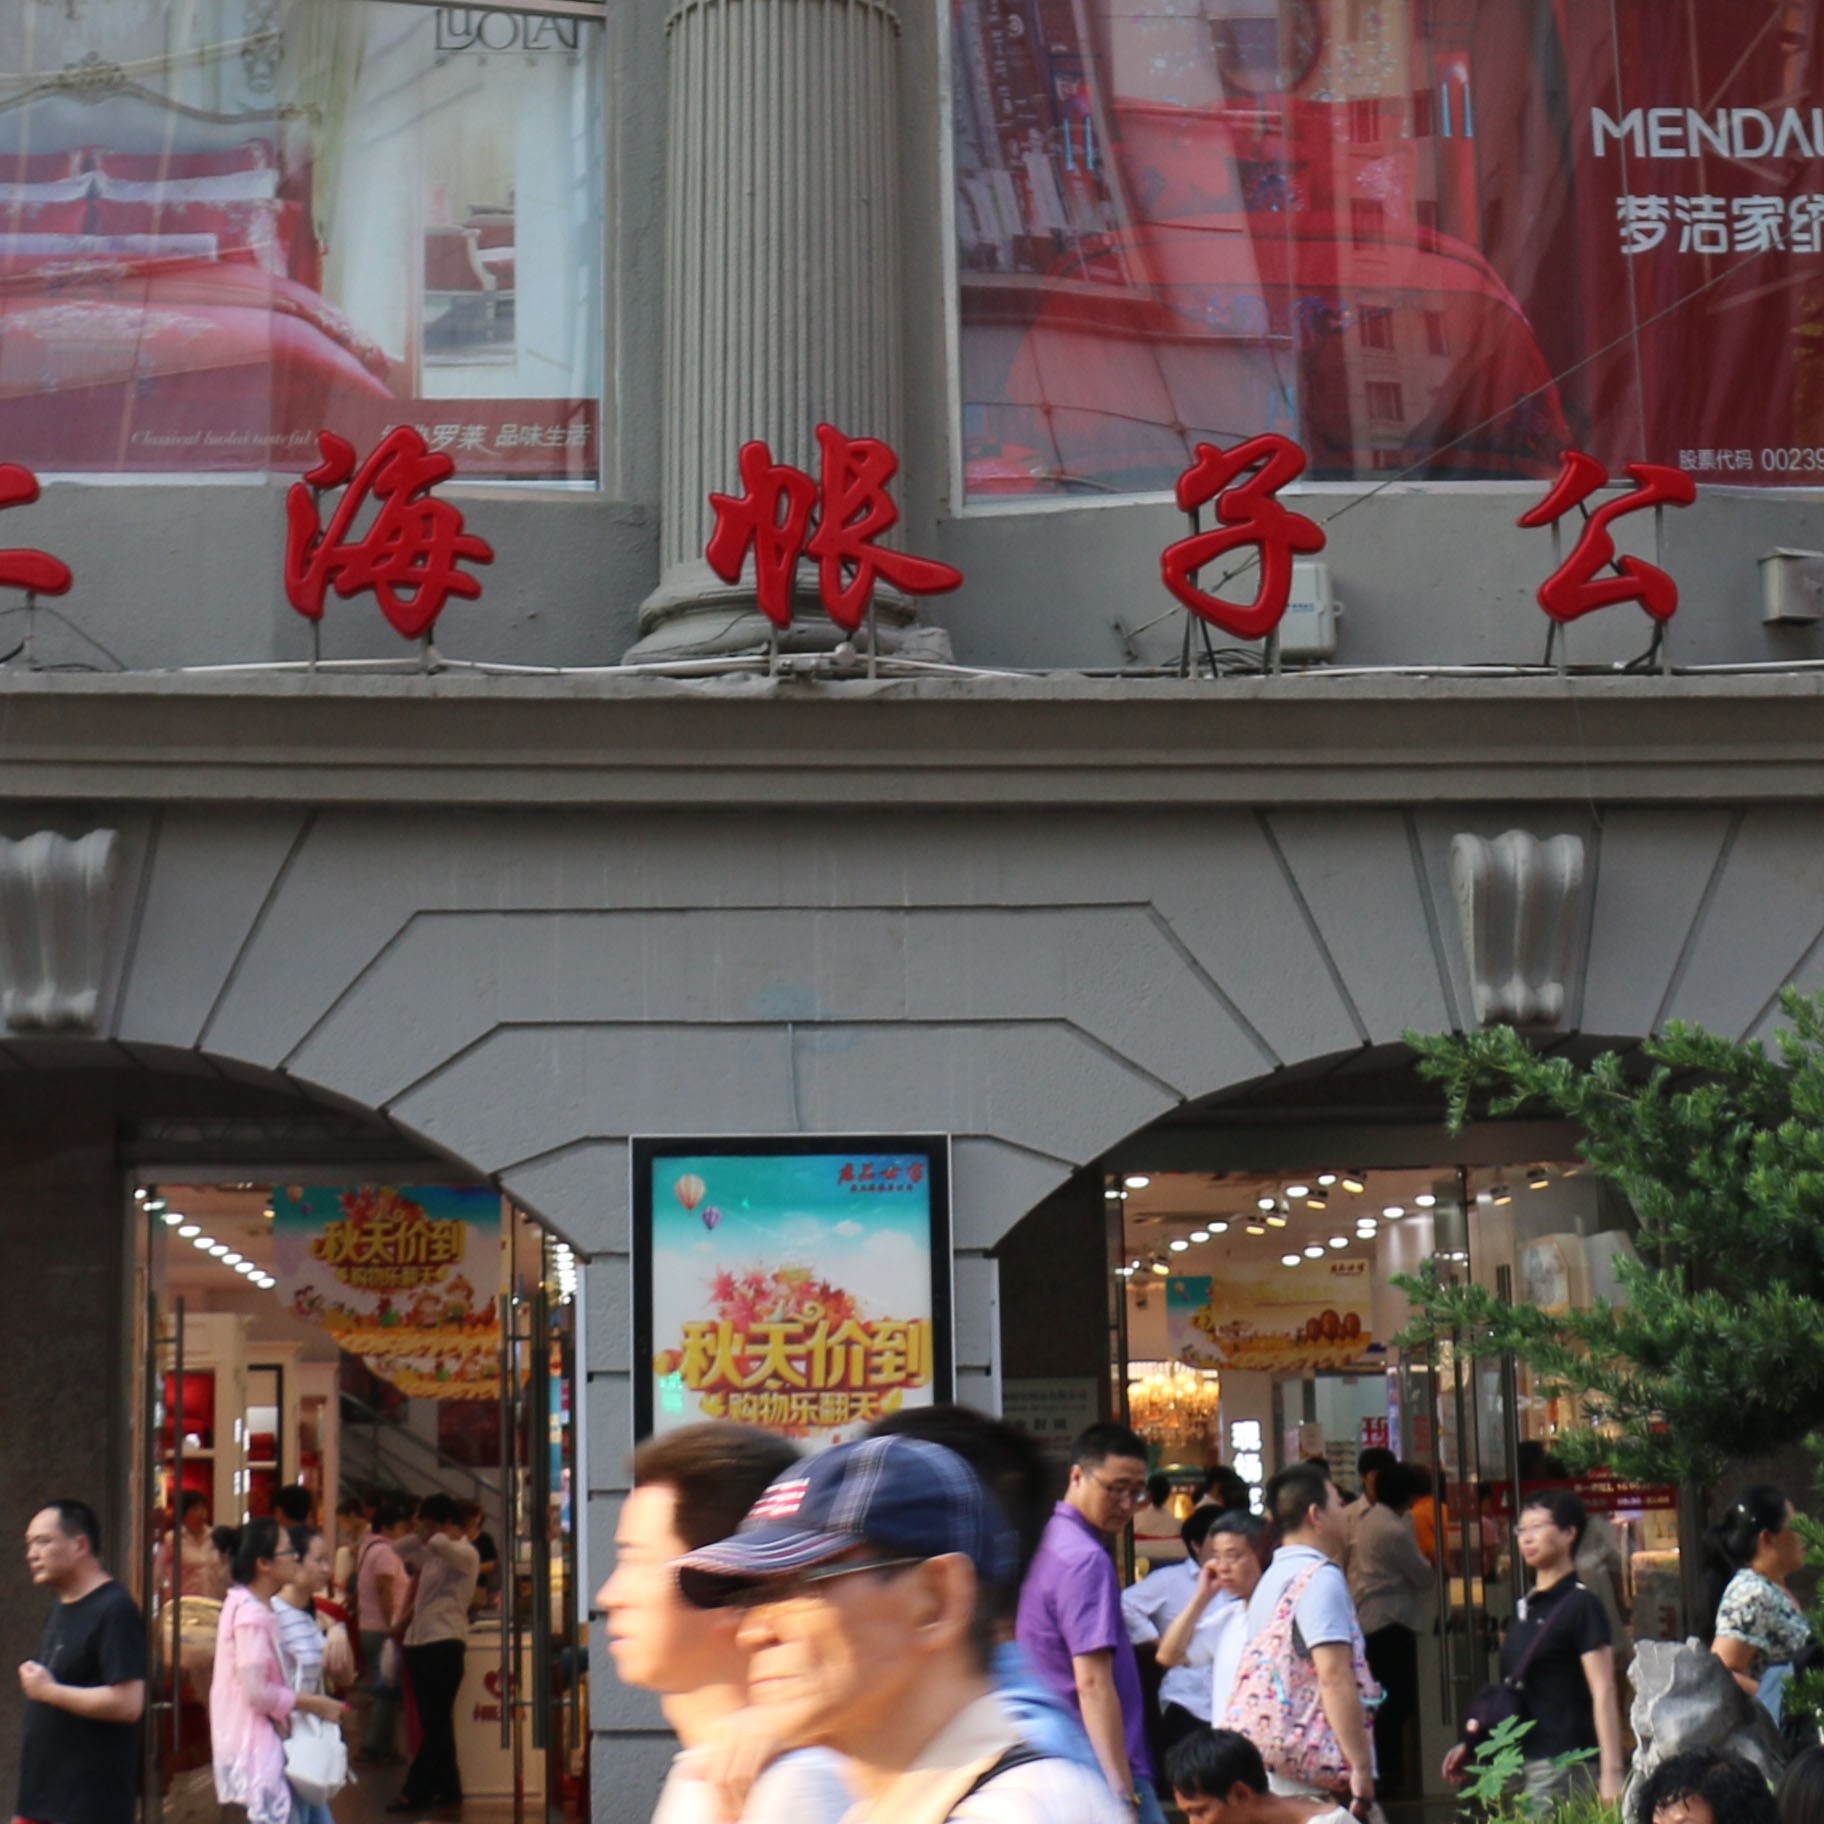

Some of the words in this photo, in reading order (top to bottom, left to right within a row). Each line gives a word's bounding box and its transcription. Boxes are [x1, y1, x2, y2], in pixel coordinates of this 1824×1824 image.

[495, 423, 592, 449] 品味生活
[1679, 449, 1753, 471] 股票代码
[681, 1319, 933, 1389] 秋天价到
[729, 1391, 880, 1425] 购物乐翻天
